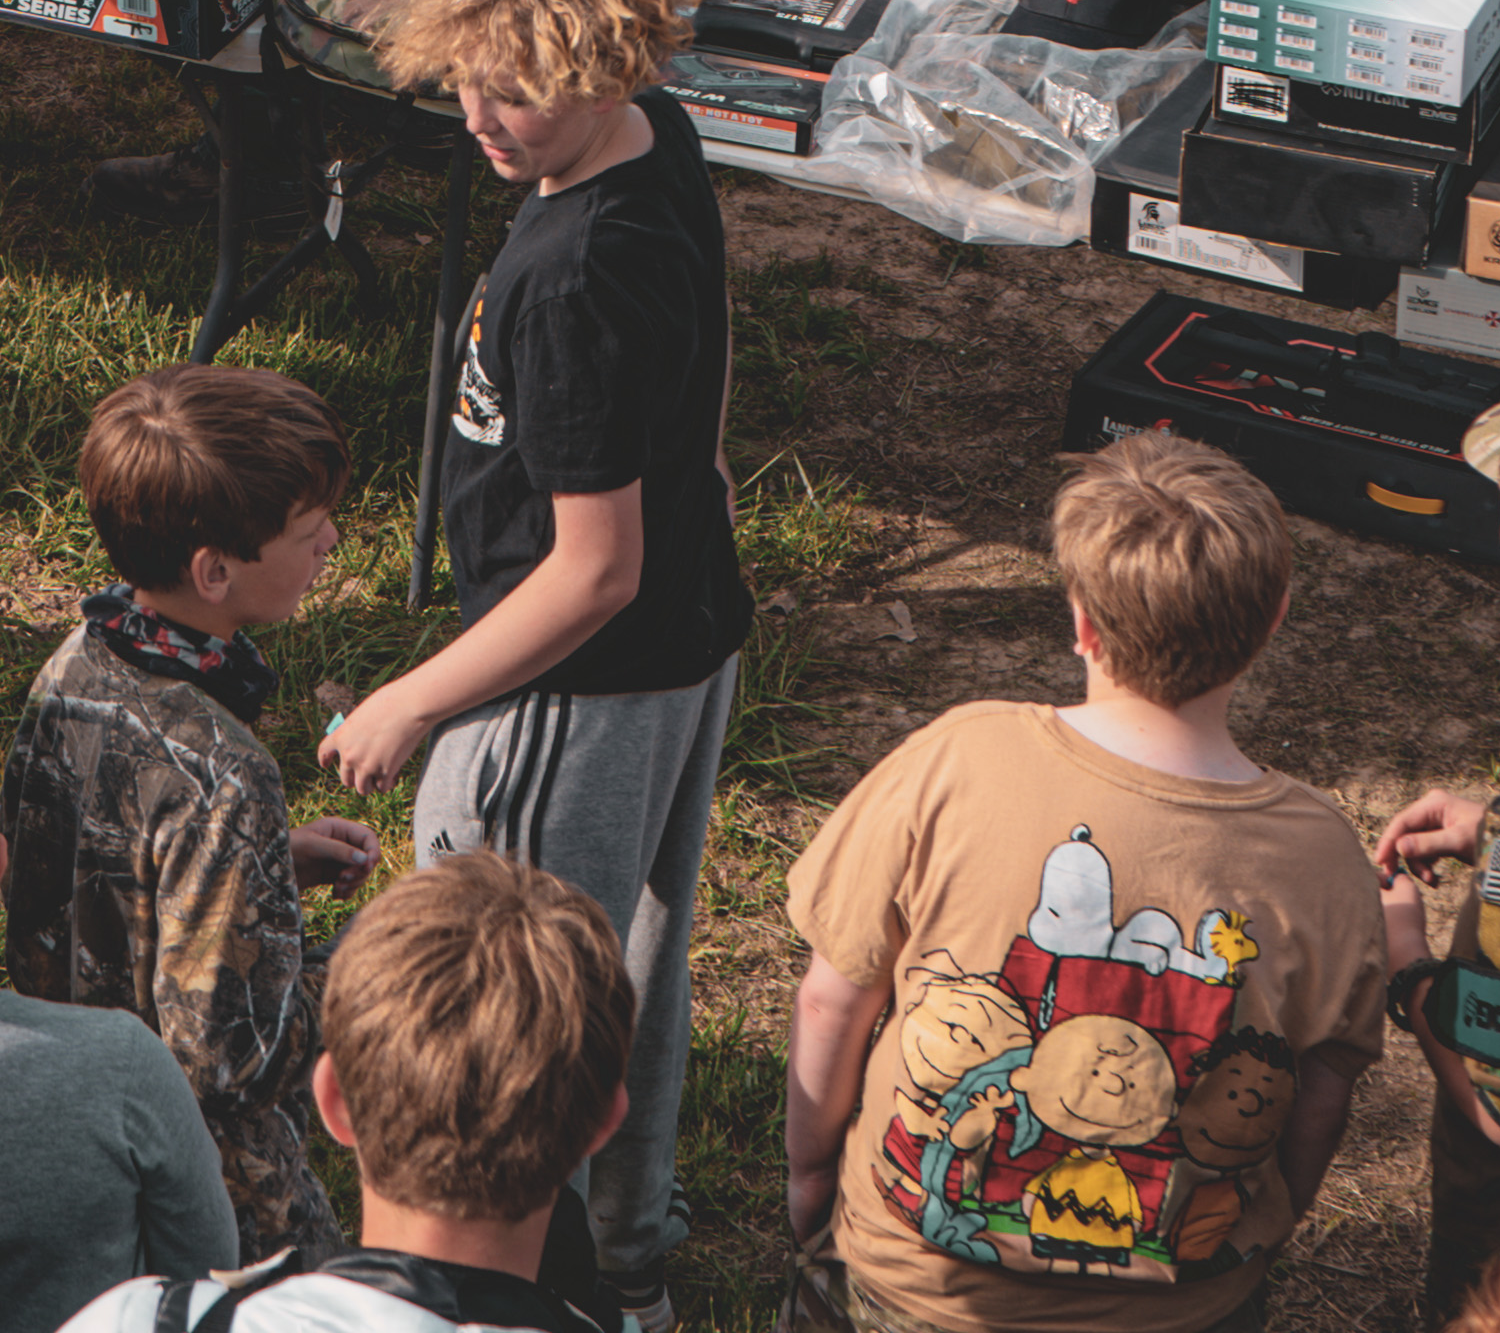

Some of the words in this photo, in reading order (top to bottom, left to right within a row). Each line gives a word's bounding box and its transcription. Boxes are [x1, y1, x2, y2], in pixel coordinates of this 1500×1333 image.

[706, 108, 729, 119] NOT
[730, 112, 740, 121] A
[741, 115, 763, 126] TOY
